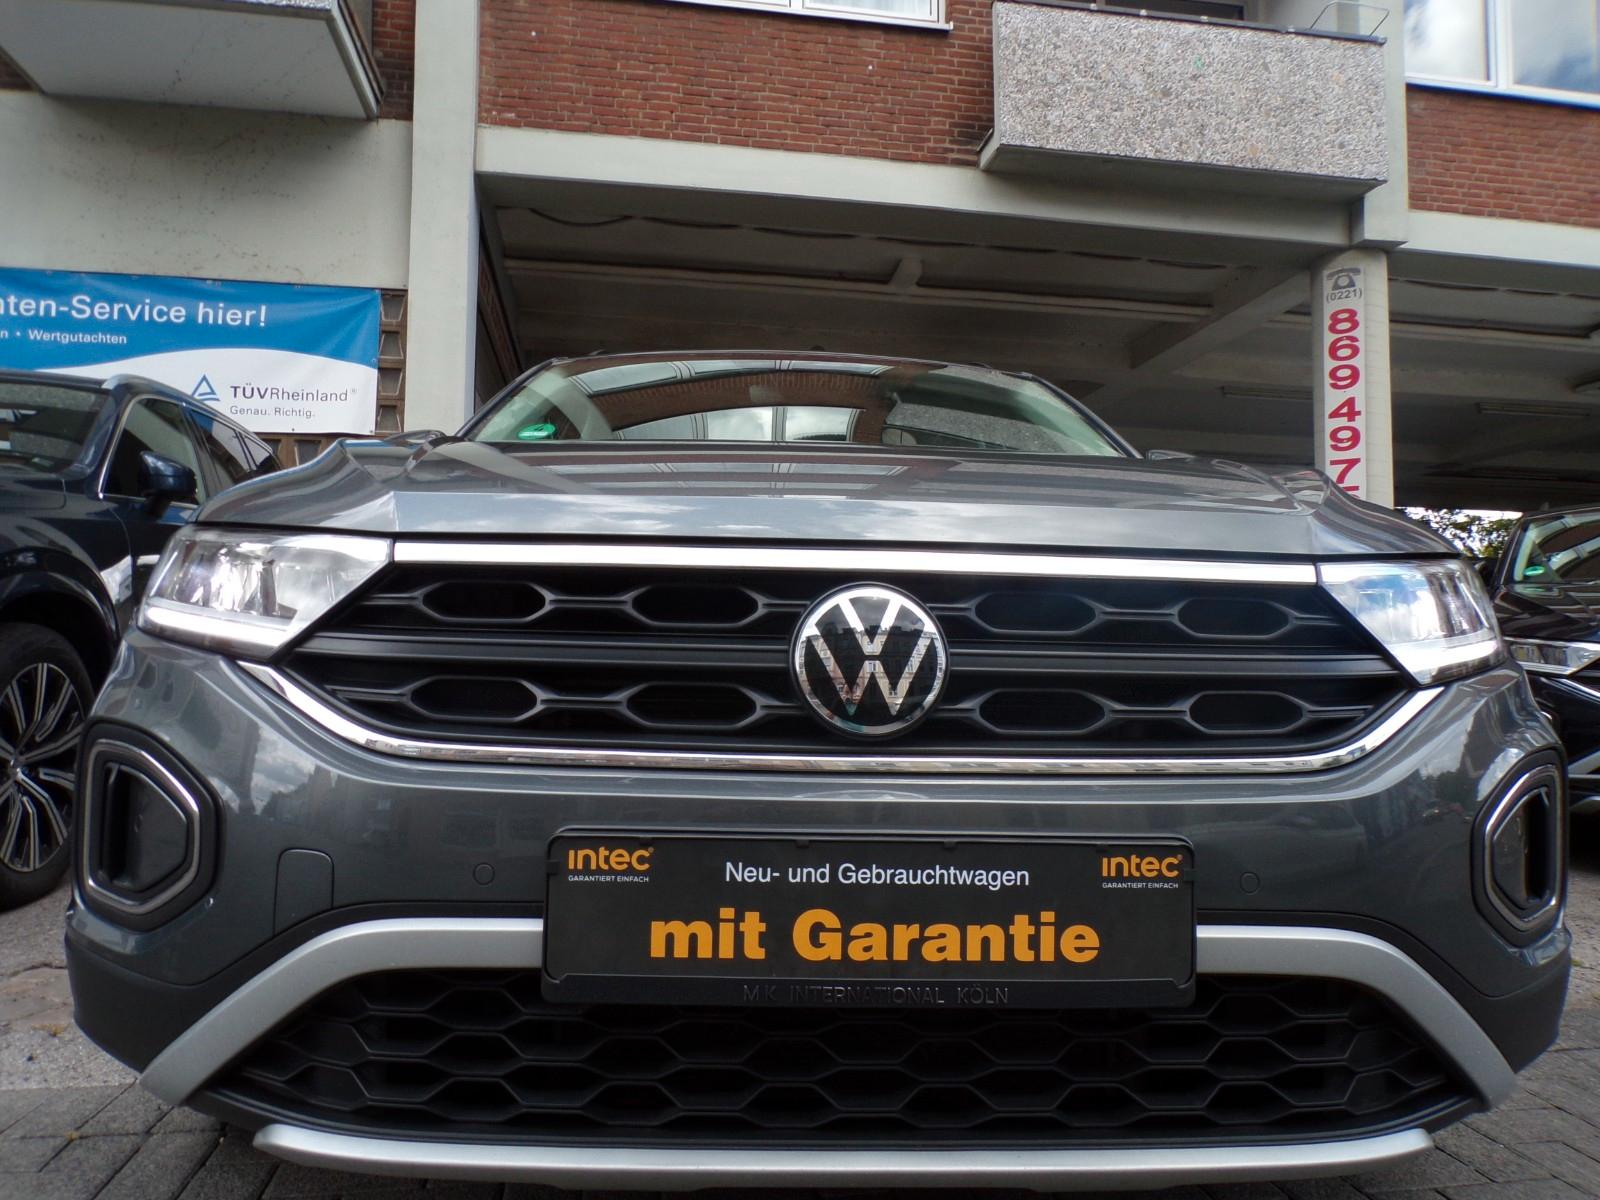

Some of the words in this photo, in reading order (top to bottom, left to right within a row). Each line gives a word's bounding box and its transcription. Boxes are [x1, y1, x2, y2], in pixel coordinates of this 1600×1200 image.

[1326, 287, 1363, 303] (0221)
[197, 303, 266, 327] hier!
[28, 329, 127, 344] Wertgutachten
[230, 405, 270, 416] Genau.
[274, 407, 315, 419] Richtig.
[568, 846, 651, 871] intec
[1102, 854, 1180, 878] intec
[616, 875, 649, 883] EINFACH
[725, 862, 780, 882] Neu-
[788, 863, 830, 883] und
[837, 863, 1030, 890] Gebrauchtwagen
[650, 907, 767, 960] mit
[792, 908, 1101, 963] Garantie
[789, 985, 945, 1004] INTERNATIONAL
[957, 984, 1009, 1005] KÖLN
